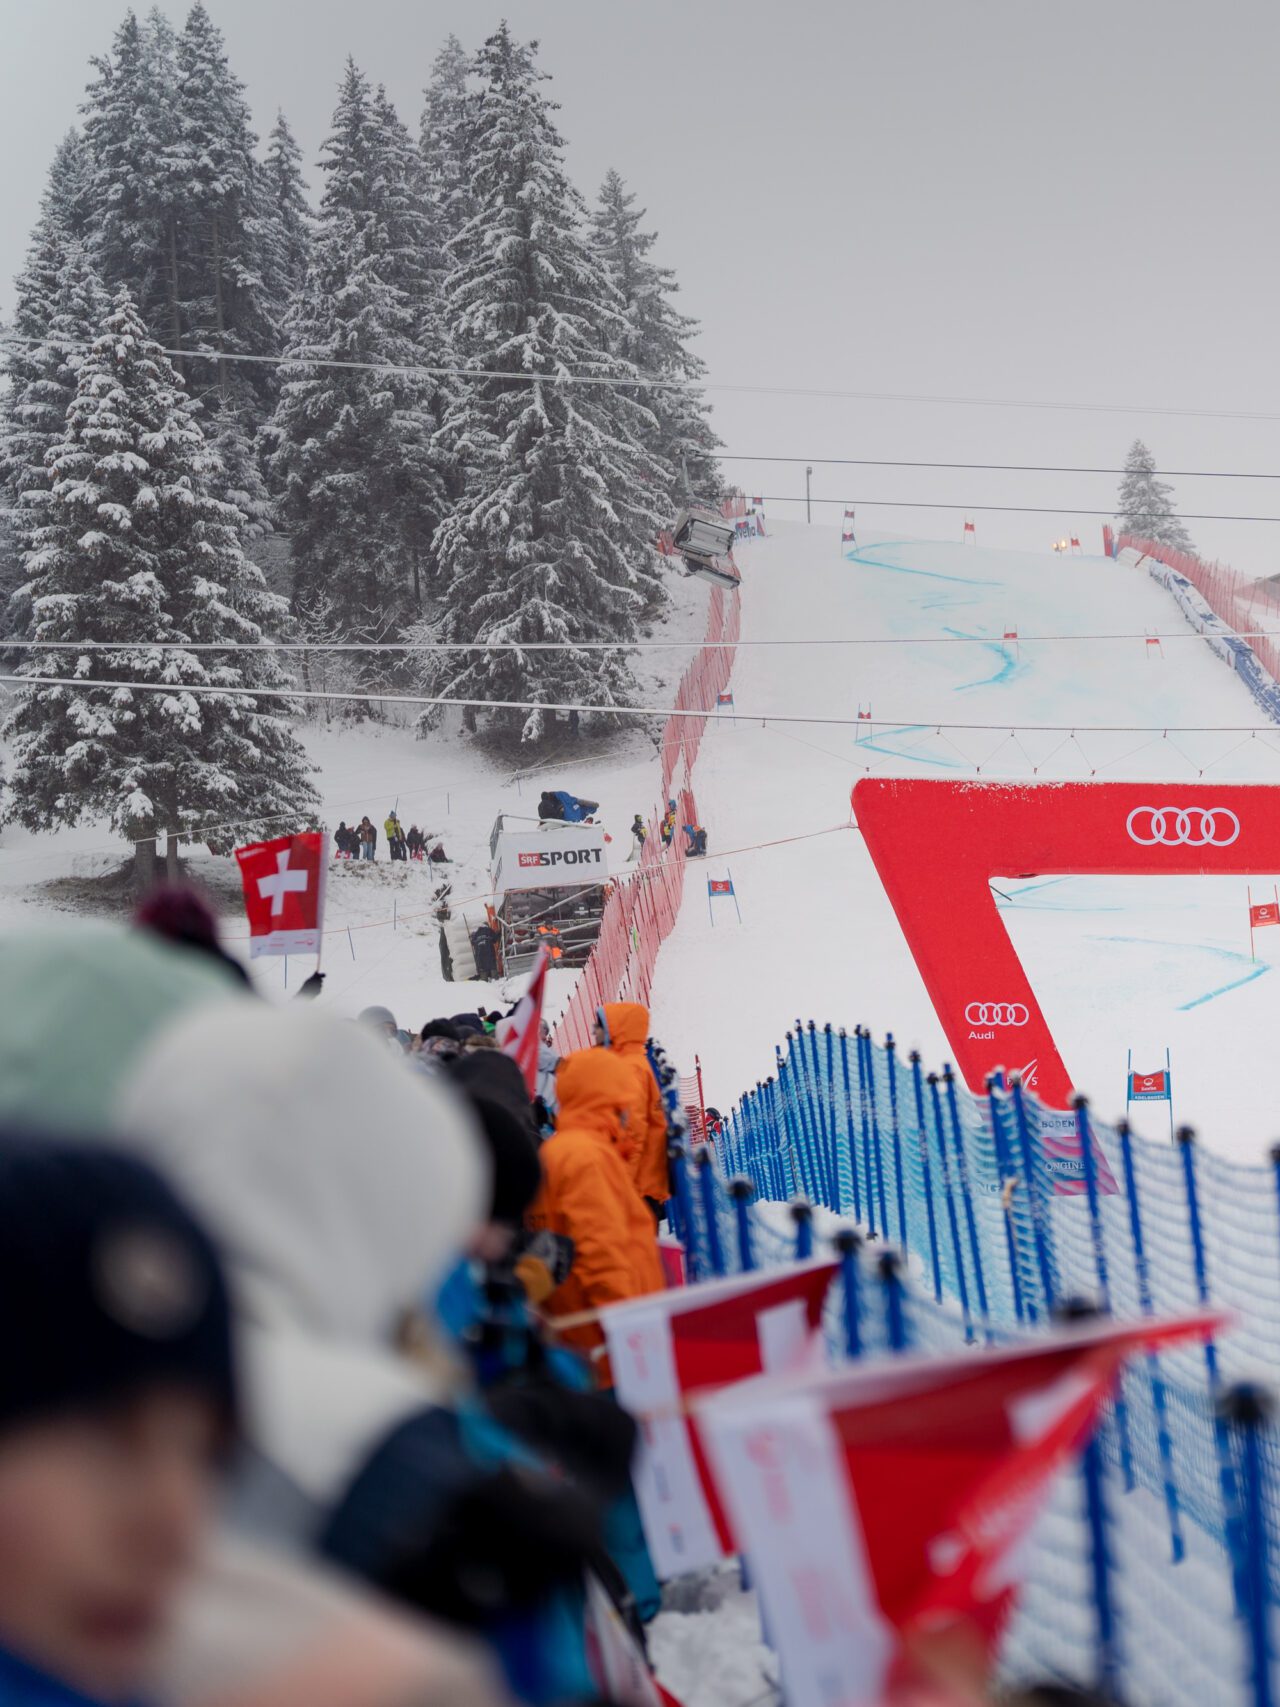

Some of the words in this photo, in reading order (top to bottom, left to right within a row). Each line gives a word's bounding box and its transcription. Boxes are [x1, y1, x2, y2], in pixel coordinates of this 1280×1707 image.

[520, 854, 538, 866] SRF
[540, 848, 602, 866] SPORT
[968, 1031, 995, 1040] Audi
